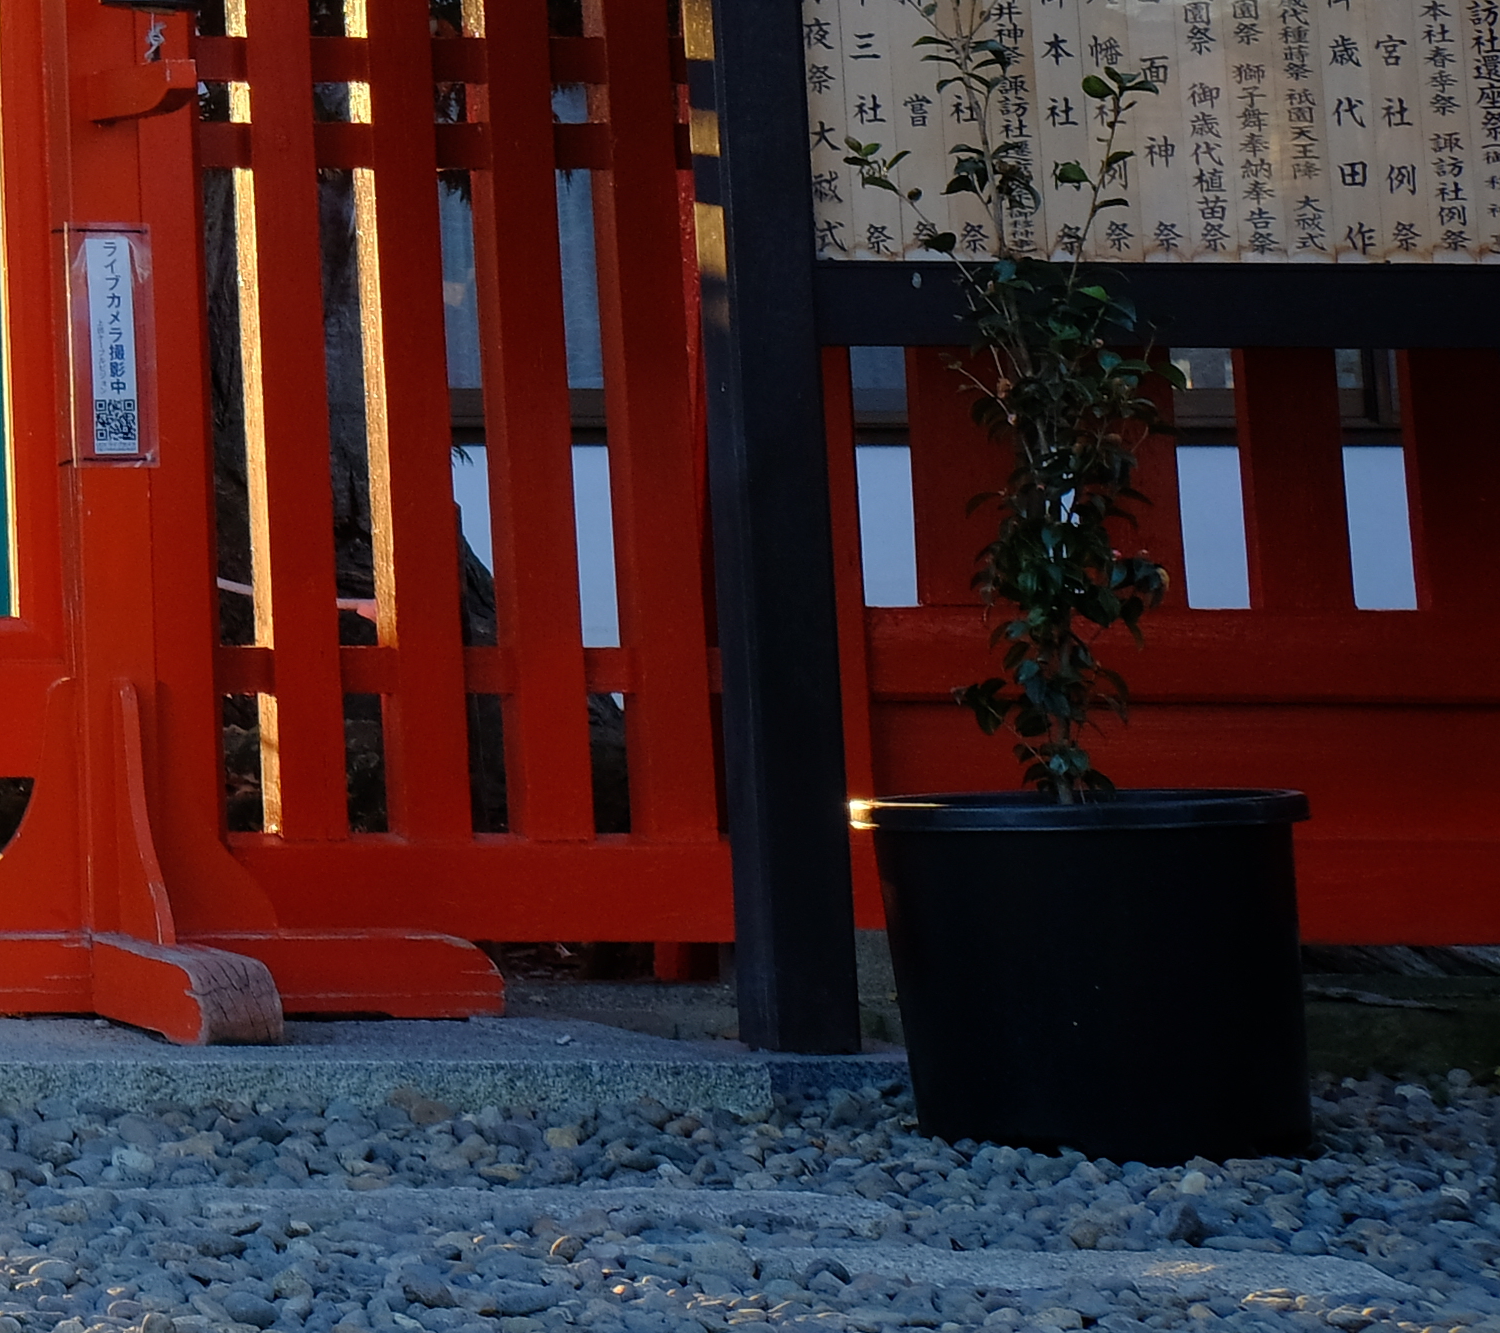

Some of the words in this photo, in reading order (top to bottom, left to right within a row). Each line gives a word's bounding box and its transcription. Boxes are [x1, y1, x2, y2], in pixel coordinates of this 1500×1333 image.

[102, 241, 127, 395] ライブカメラ撮影中
